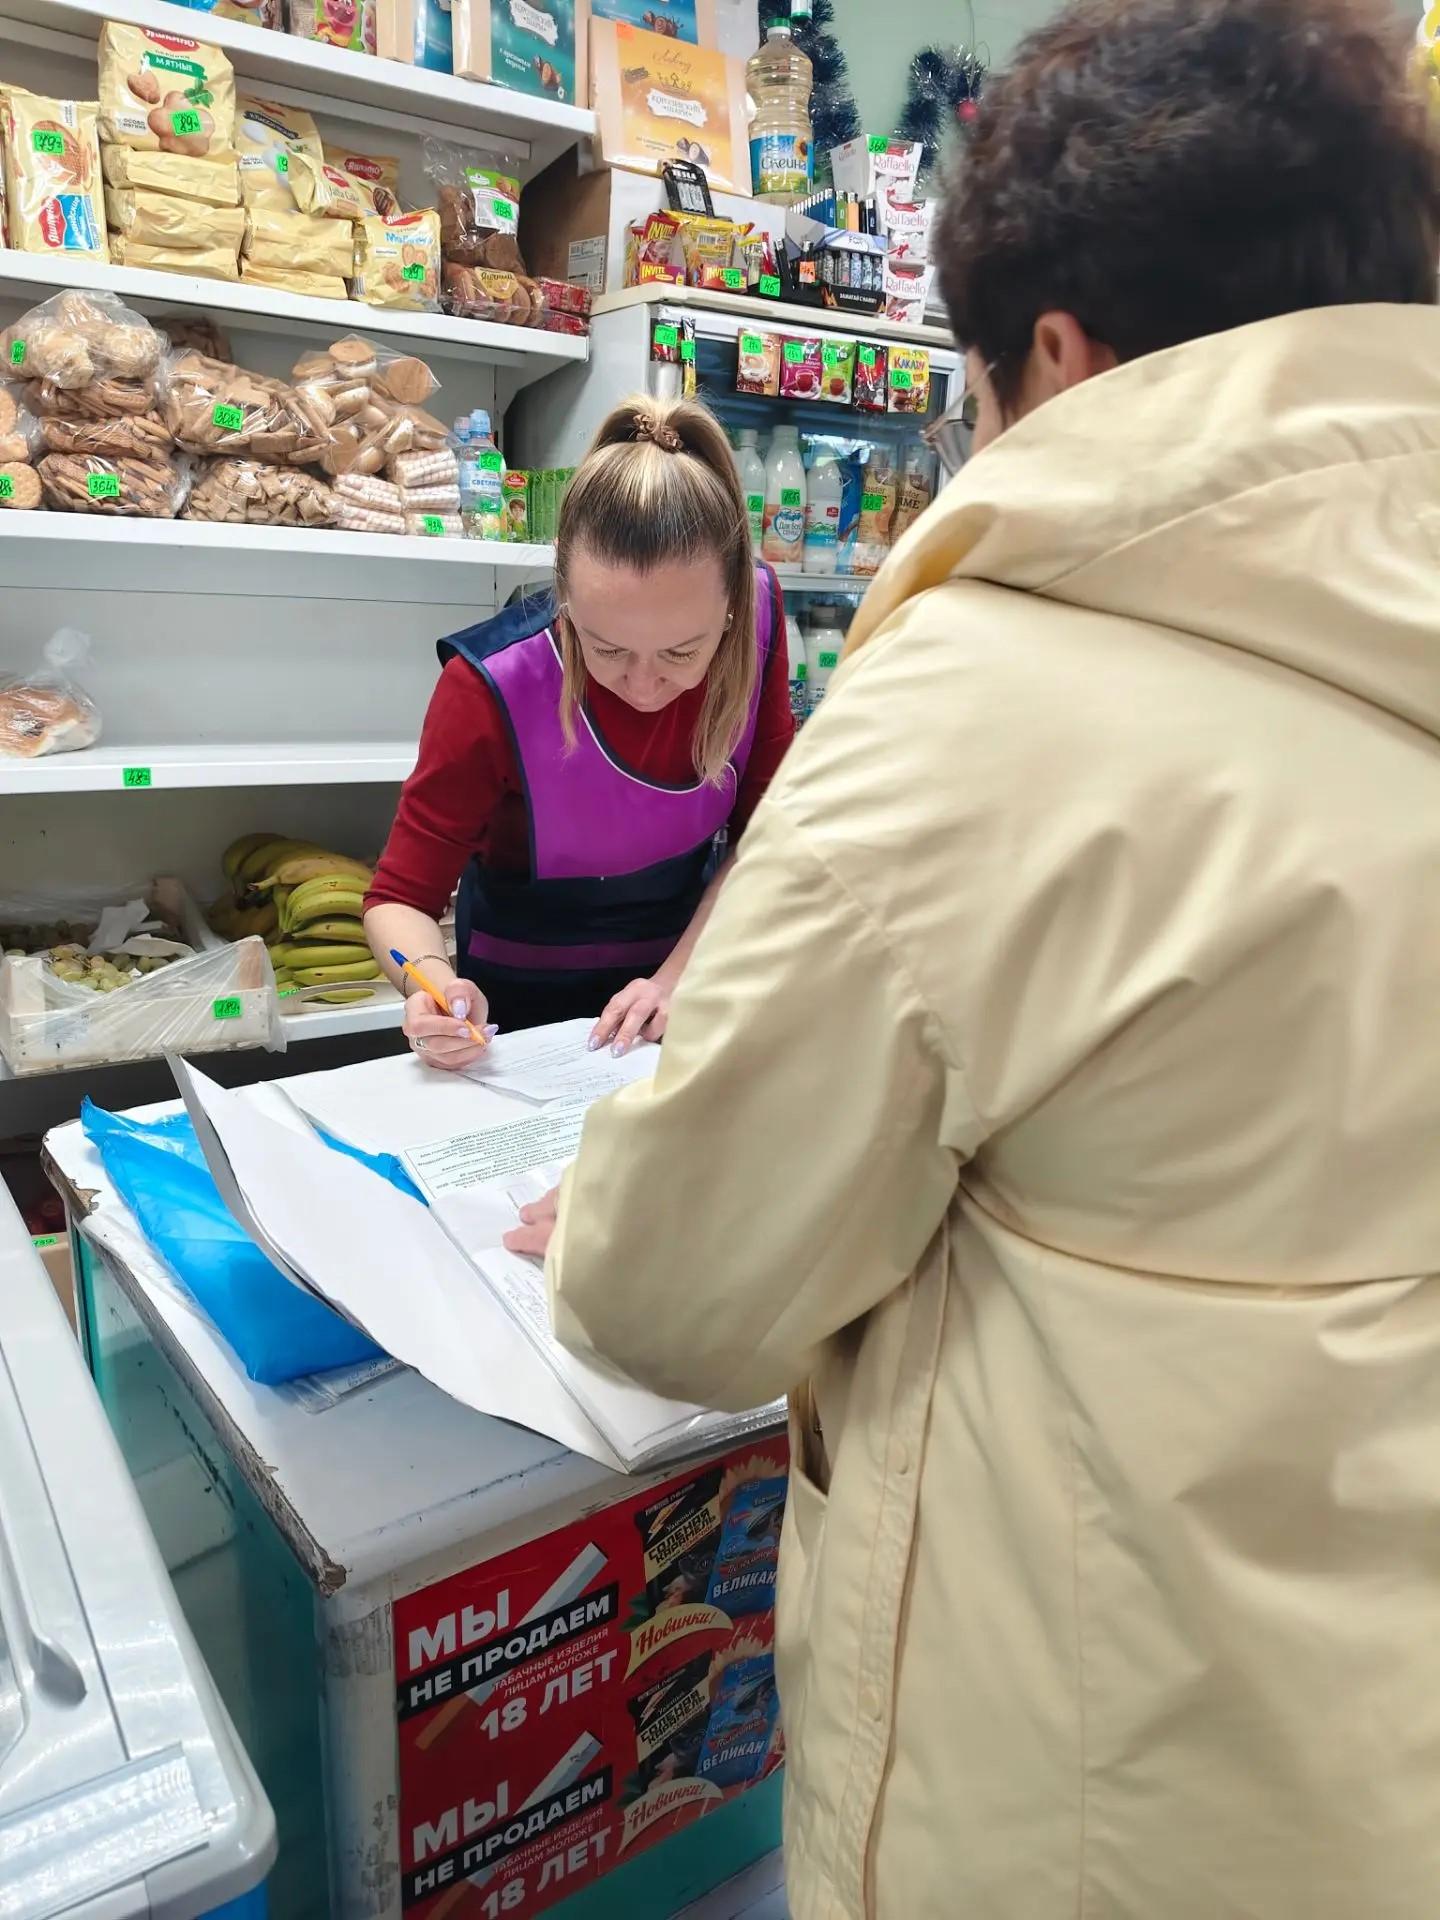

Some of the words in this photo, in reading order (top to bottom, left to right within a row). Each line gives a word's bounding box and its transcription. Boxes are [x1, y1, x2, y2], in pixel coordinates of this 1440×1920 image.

[155, 57, 193, 72] МЯТНЫЕ
[873, 155, 916, 171] Raffaello
[885, 209, 929, 226] Raffaello
[641, 263, 665, 279] INVITE
[885, 277, 926, 295] Raffaello
[713, 1570, 776, 1598] ВЕЛИКАН
[408, 1588, 510, 1671] МЫ
[410, 1670, 452, 1708] НЕ
[461, 1594, 610, 1683] ПРОДАЕМ
[636, 1611, 718, 1657] Новинки!
[494, 1657, 553, 1691] ТАБАЧНЫЕ
[556, 1628, 609, 1660] ИЗДЕЛИЯ
[503, 1671, 547, 1699] ЛИЦАМ
[549, 1645, 600, 1677] МОЛОЖЕ
[479, 1696, 527, 1741] 18
[539, 1648, 618, 1716] ЛЕТ
[702, 1739, 766, 1772] ВЕЛИКАН
[412, 1779, 510, 1863] МЫ
[627, 1783, 708, 1830] Новинки!
[414, 1859, 454, 1897] НЕ
[463, 1775, 604, 1870] ПРОДАЕМ
[495, 1836, 551, 1873] ТАБАЧНЫЕ
[553, 1807, 604, 1841] ИЗДЕЛИЯ
[502, 1853, 544, 1881] ЛИЦАМ
[546, 1823, 594, 1856] МОЛОЖЕ
[480, 1877, 526, 1920] 18
[536, 1825, 612, 1893] ЛЕТ
